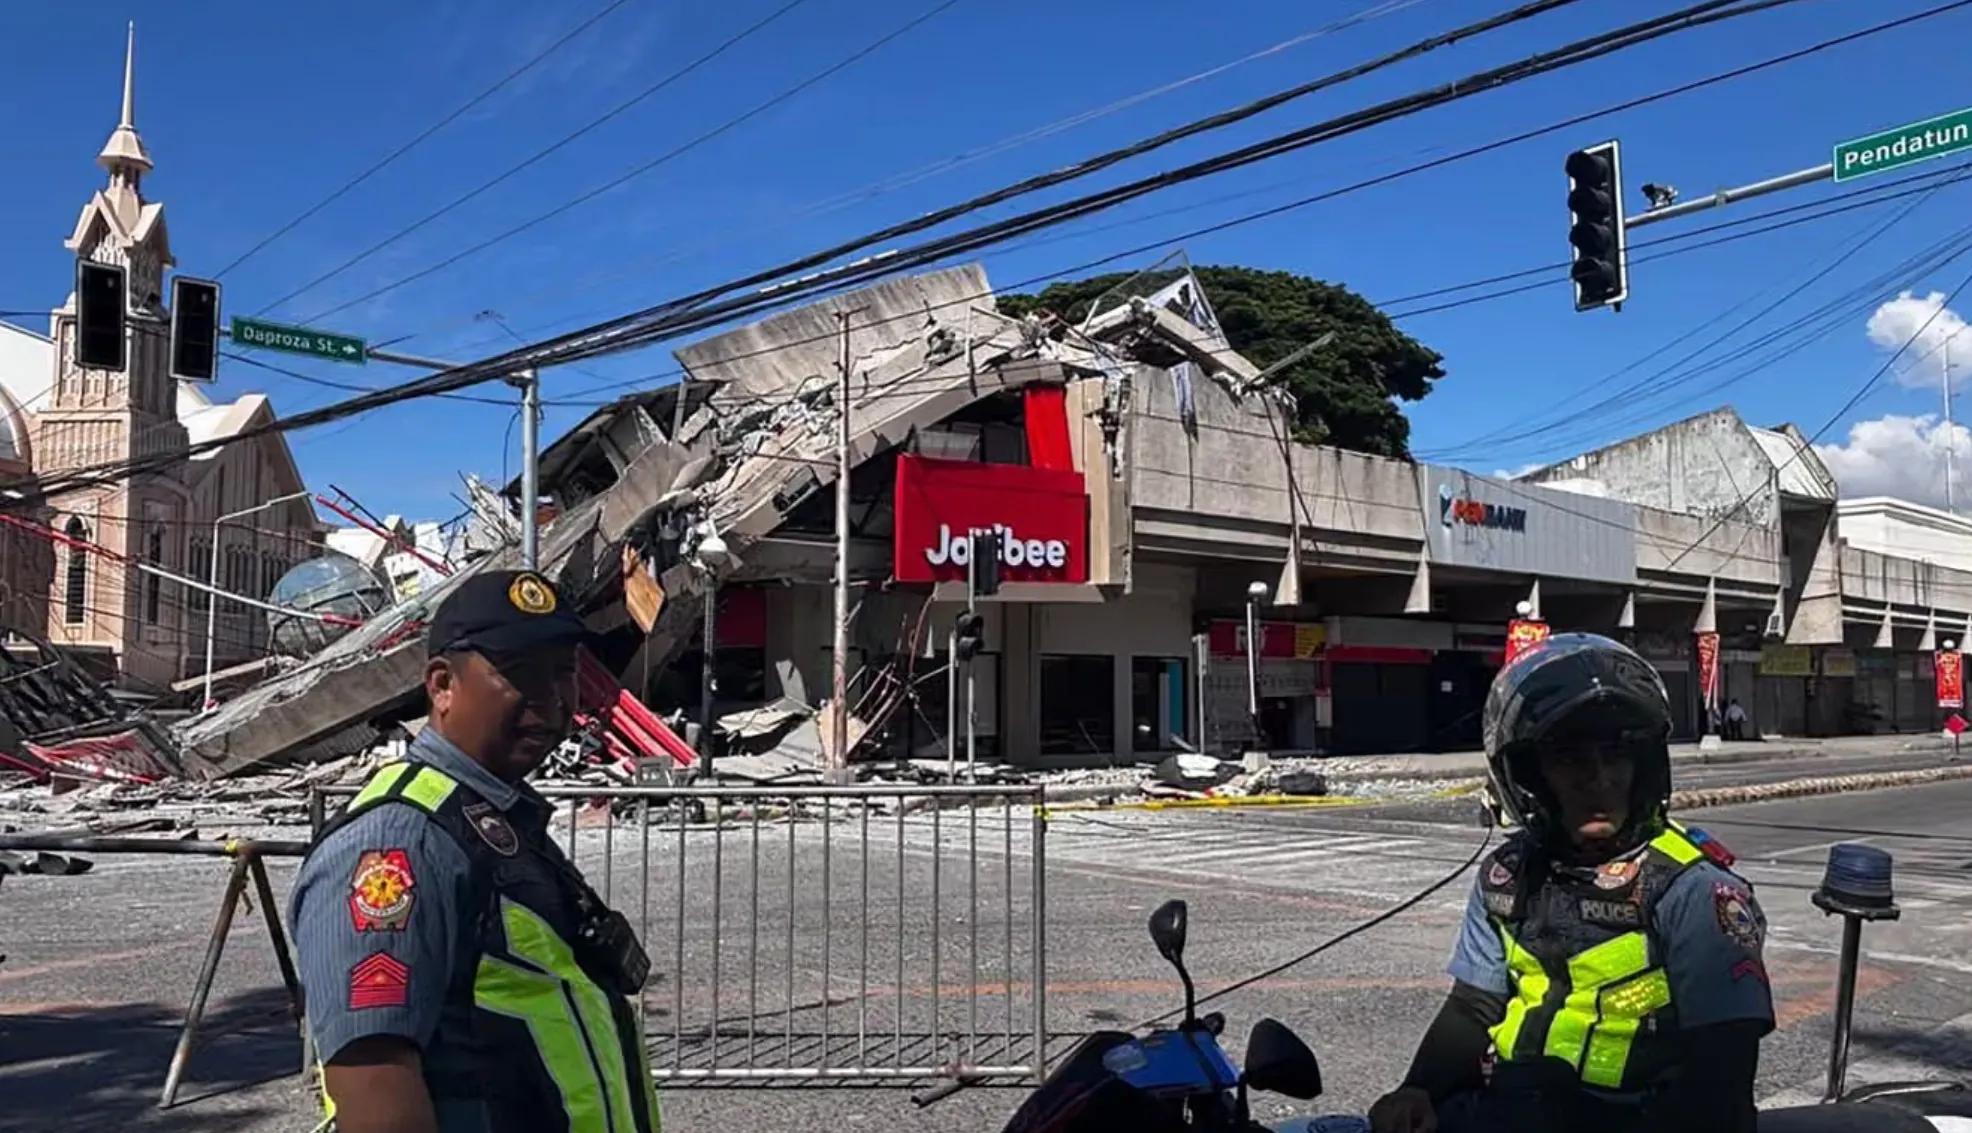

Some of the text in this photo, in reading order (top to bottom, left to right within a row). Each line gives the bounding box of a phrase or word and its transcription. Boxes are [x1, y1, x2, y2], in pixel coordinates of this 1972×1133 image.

[1844, 123, 1968, 170] Pendatun
[243, 326, 310, 348] Daproza
[1580, 899, 1638, 923] POLICE
